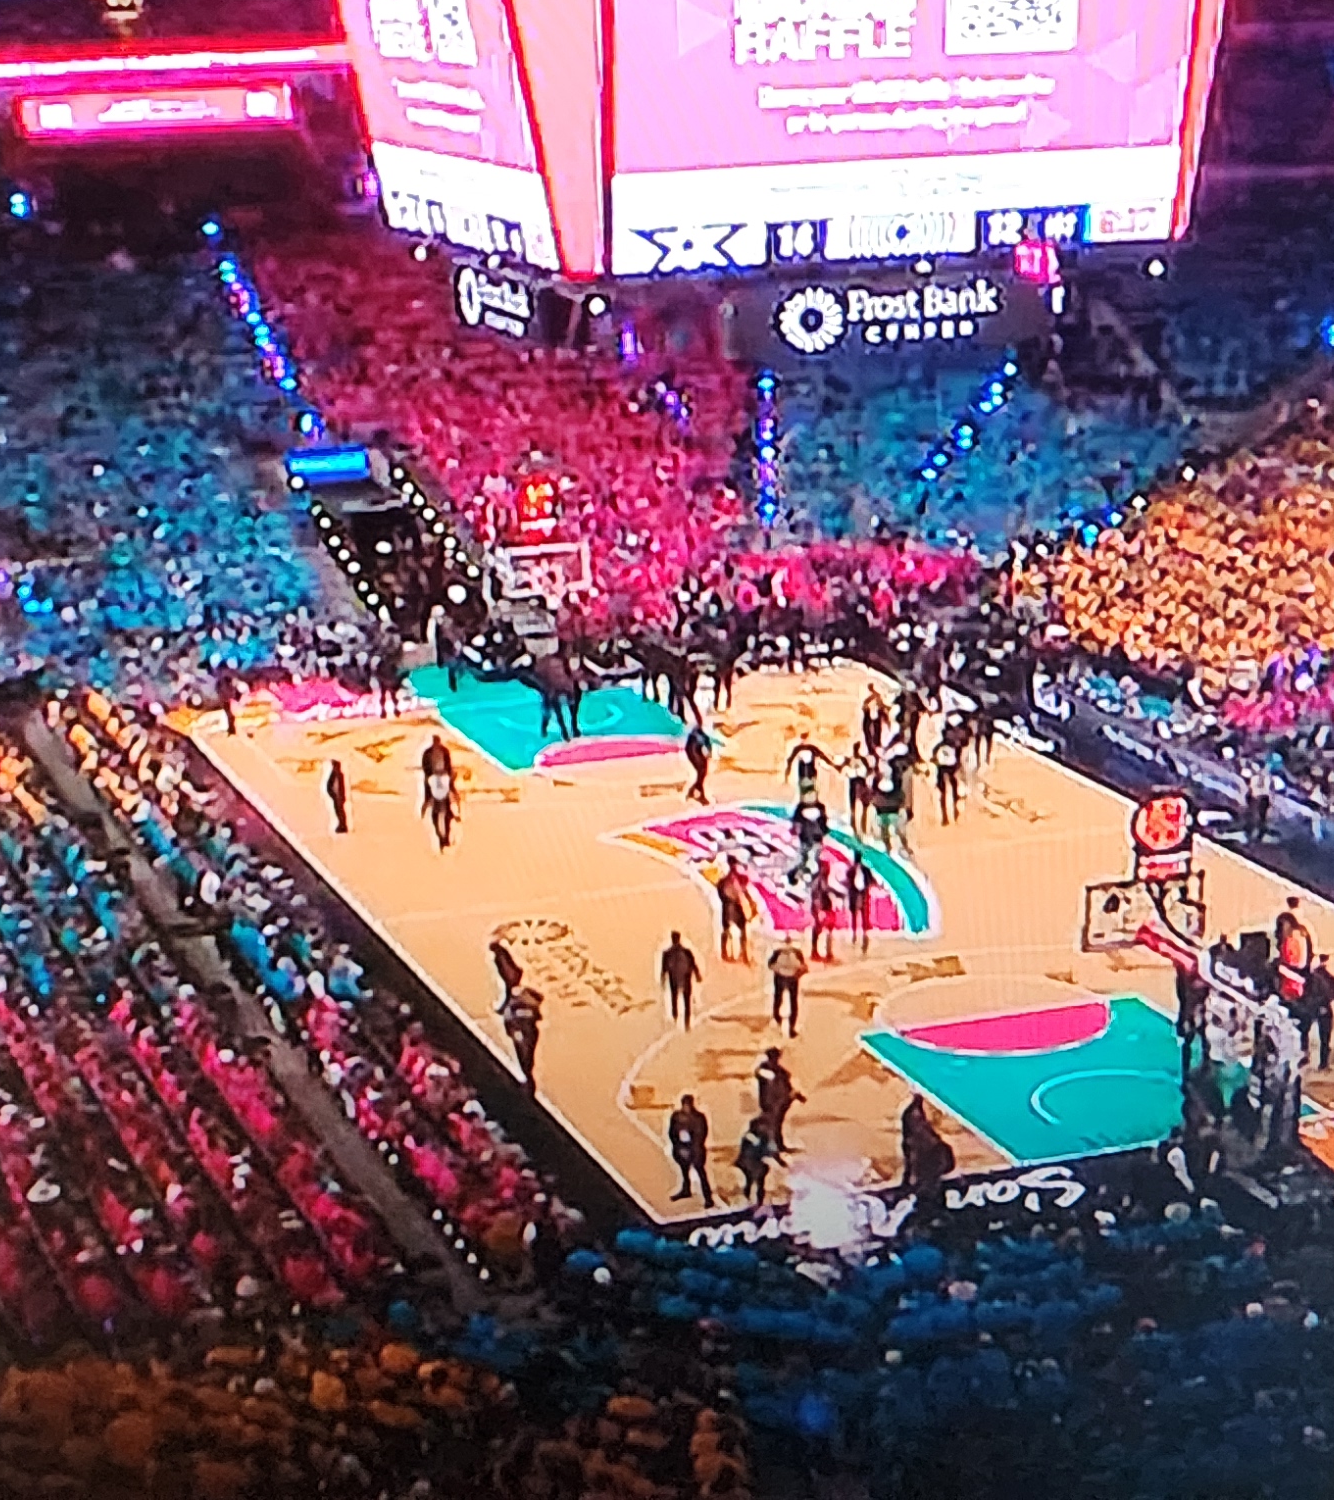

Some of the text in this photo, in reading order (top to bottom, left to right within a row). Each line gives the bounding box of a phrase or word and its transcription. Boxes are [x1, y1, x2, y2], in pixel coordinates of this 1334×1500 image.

[733, 16, 915, 66] RAFFLE
[846, 278, 999, 322] Frost Bank
